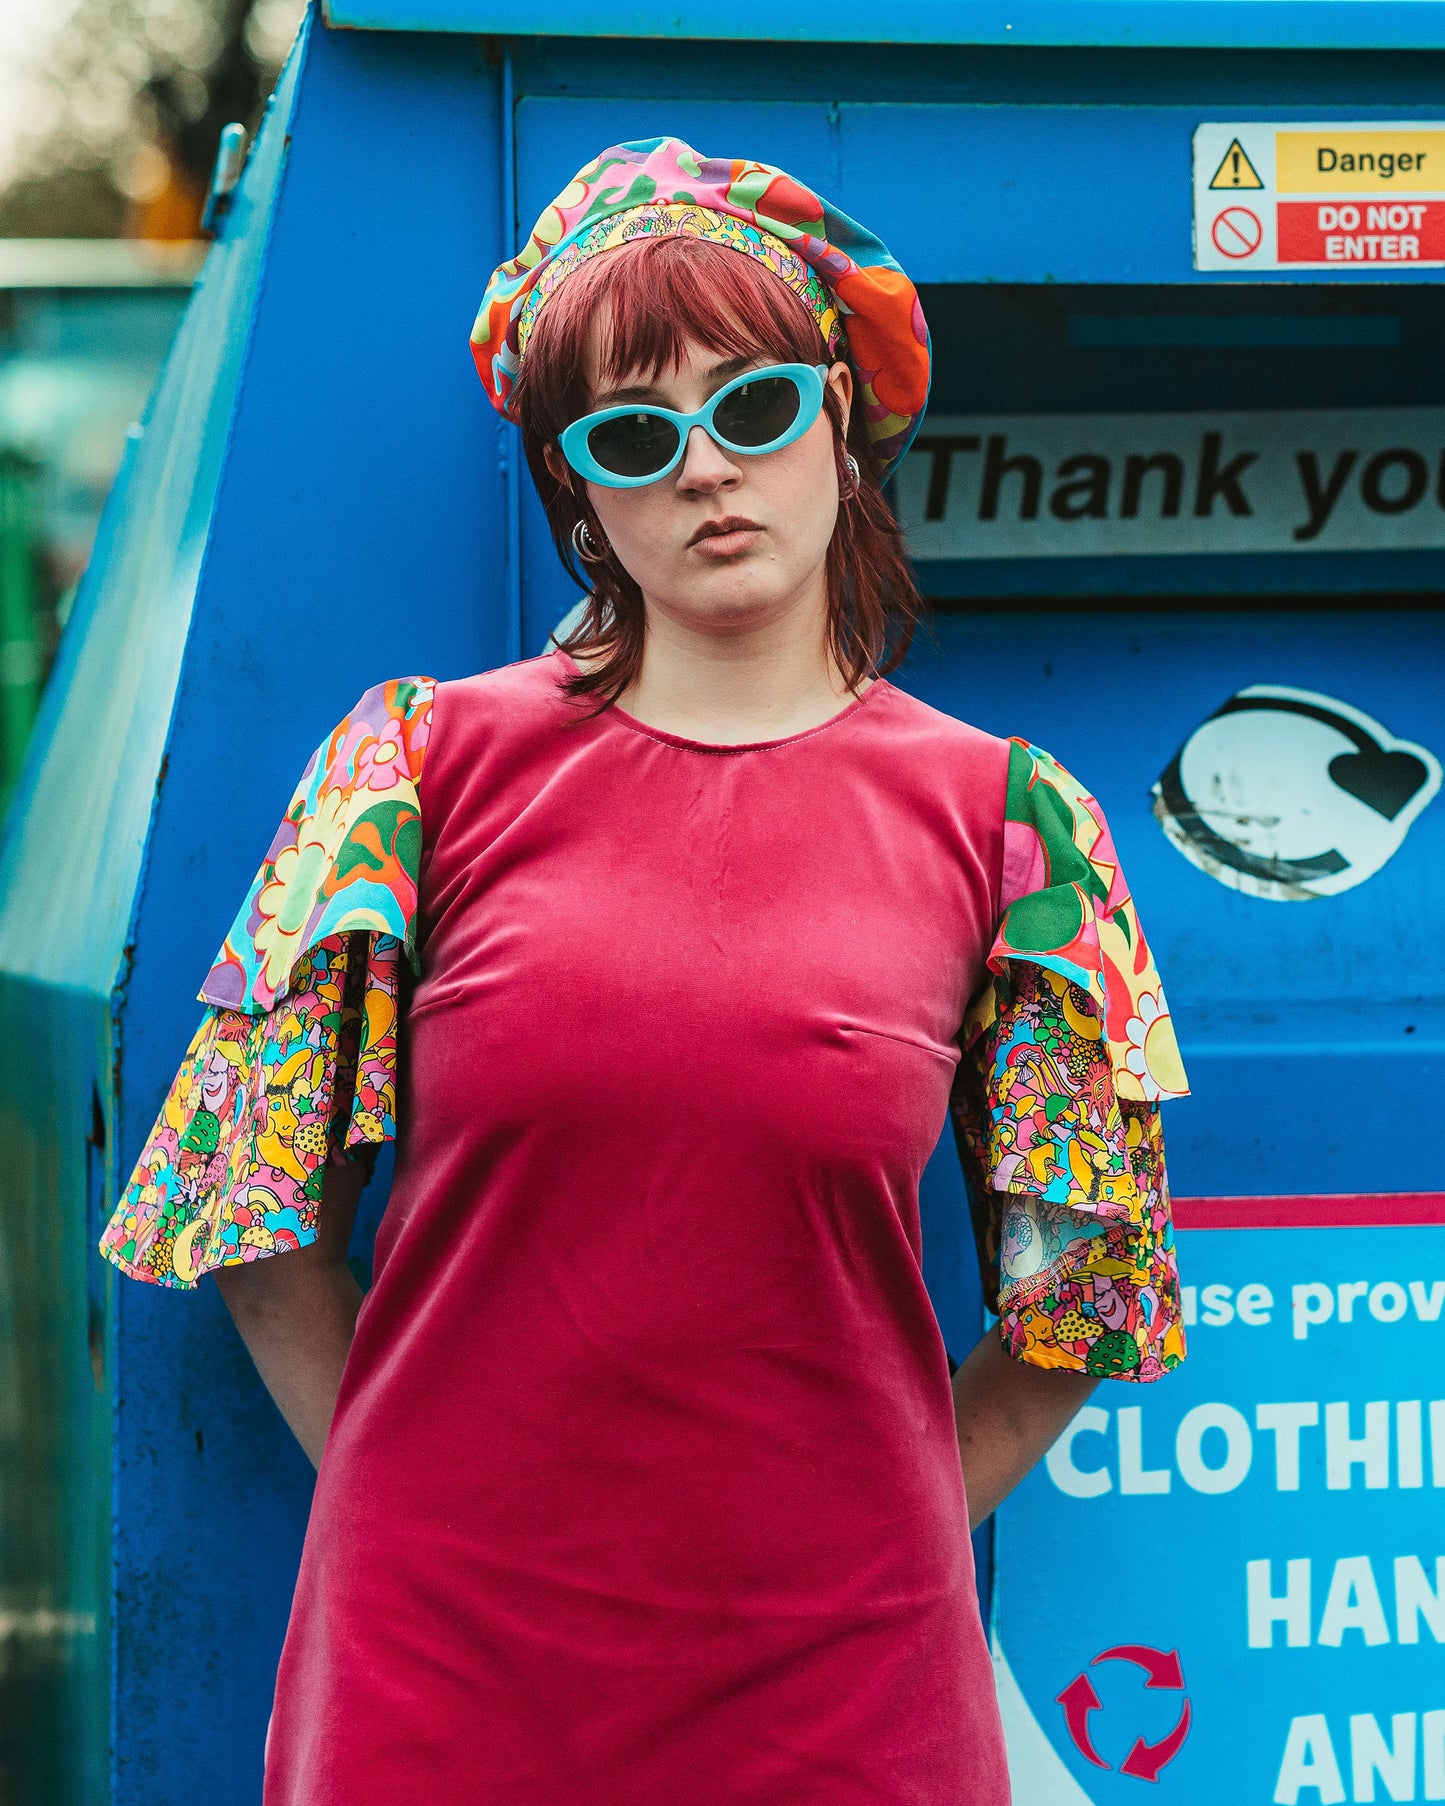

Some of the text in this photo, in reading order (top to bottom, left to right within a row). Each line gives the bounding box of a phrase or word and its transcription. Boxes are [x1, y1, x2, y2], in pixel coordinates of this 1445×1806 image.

[1317, 148, 1427, 178] Danger
[1318, 205, 1427, 231] DO NOT
[1325, 236, 1420, 260] ENTER
[907, 432, 1445, 541] Thank yo
